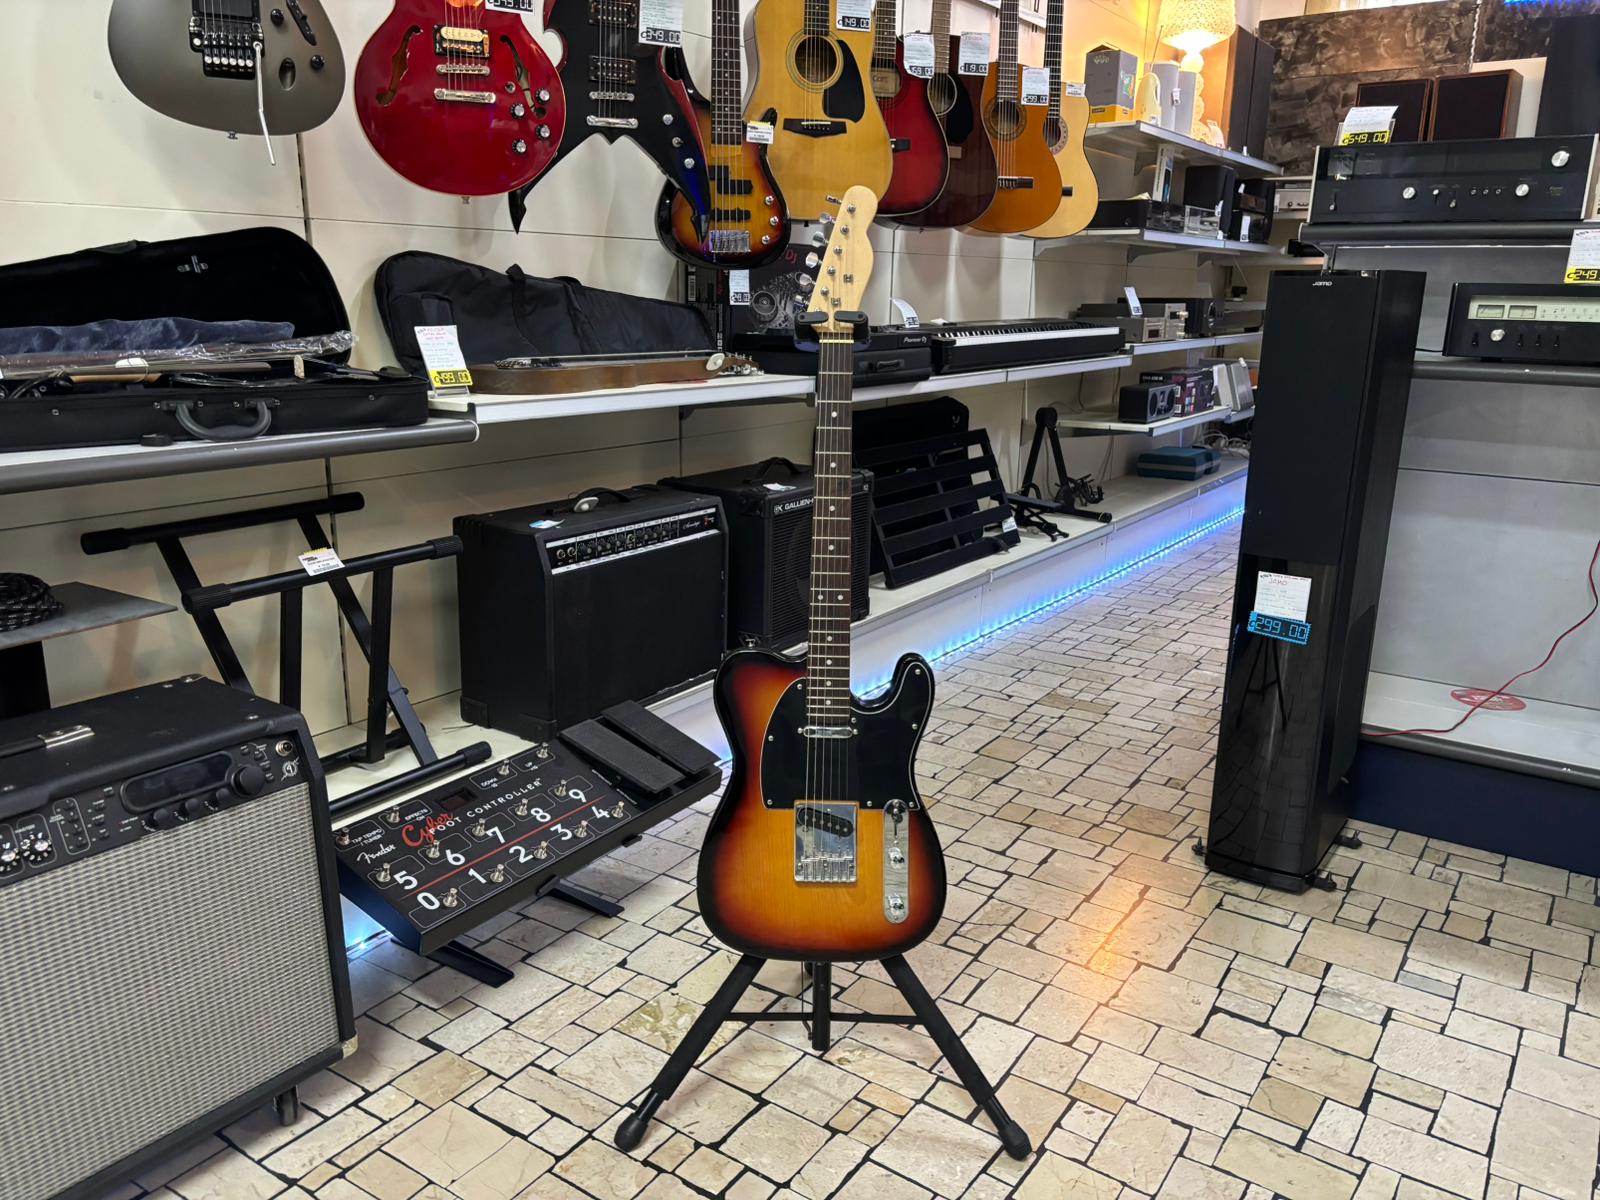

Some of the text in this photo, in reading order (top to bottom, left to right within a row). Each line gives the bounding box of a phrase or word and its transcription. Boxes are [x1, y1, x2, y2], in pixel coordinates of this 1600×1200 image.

[568, 788, 587, 803] 9
[530, 807, 551, 823] 8
[591, 805, 610, 819] 4
[486, 826, 506, 844] 7
[550, 823, 573, 841] 3
[357, 843, 397, 864] Fender
[445, 849, 466, 866] 6
[508, 845, 534, 864] 2
[393, 870, 418, 890] 5
[468, 868, 487, 884] 1
[416, 892, 440, 910] 0
